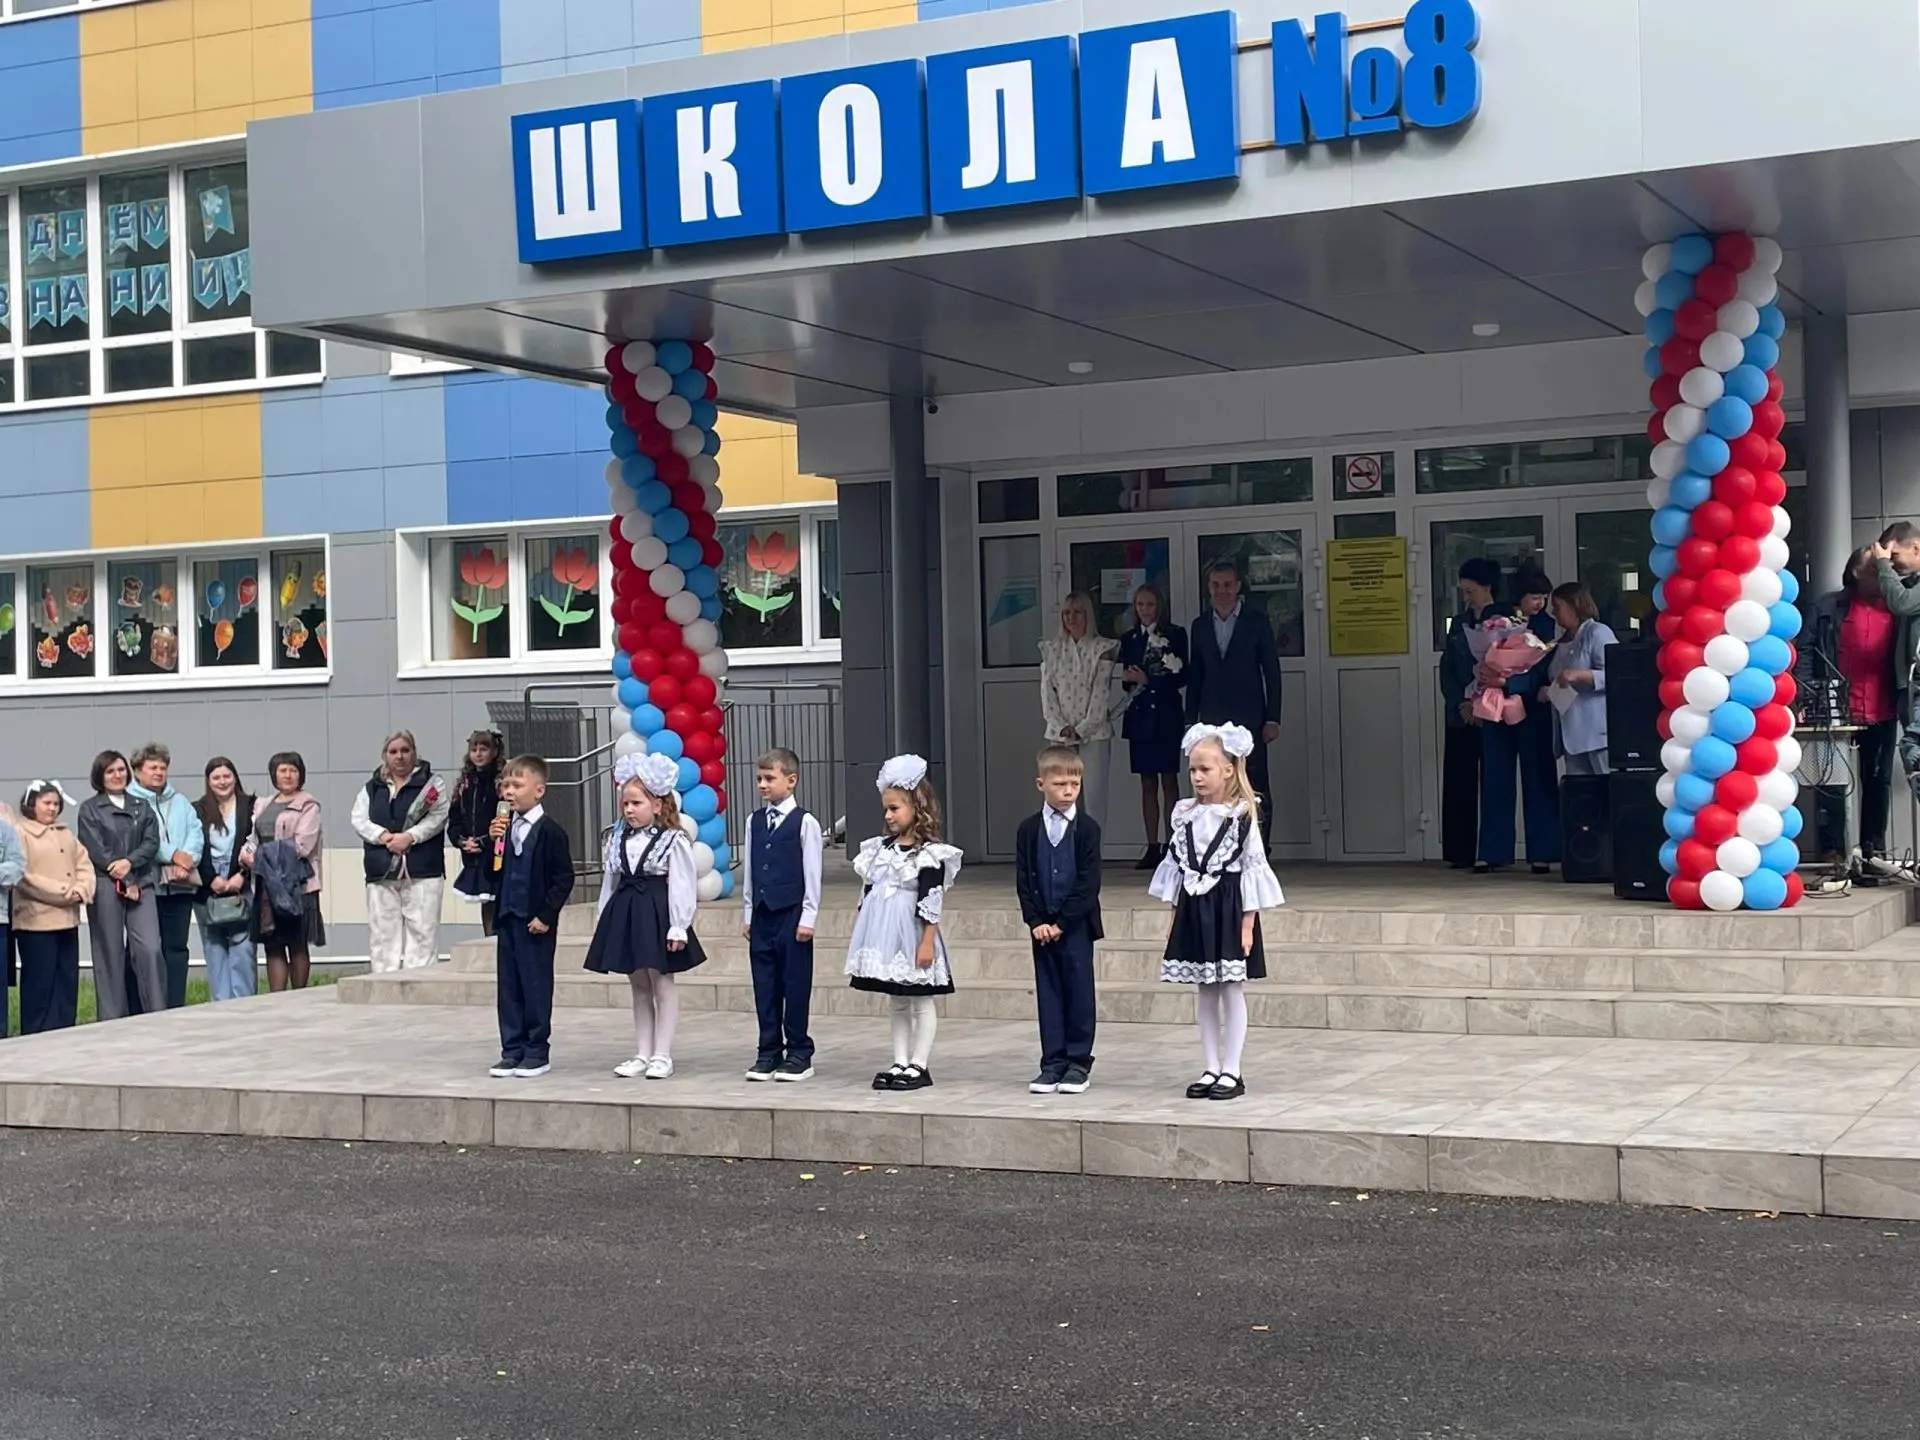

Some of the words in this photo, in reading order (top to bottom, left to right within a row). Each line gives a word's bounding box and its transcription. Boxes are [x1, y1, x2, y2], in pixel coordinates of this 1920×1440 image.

[529, 37, 1195, 240] ШКОЛА
[1272, 0, 1480, 145] №8
[30, 204, 169, 251] ДНЁМ
